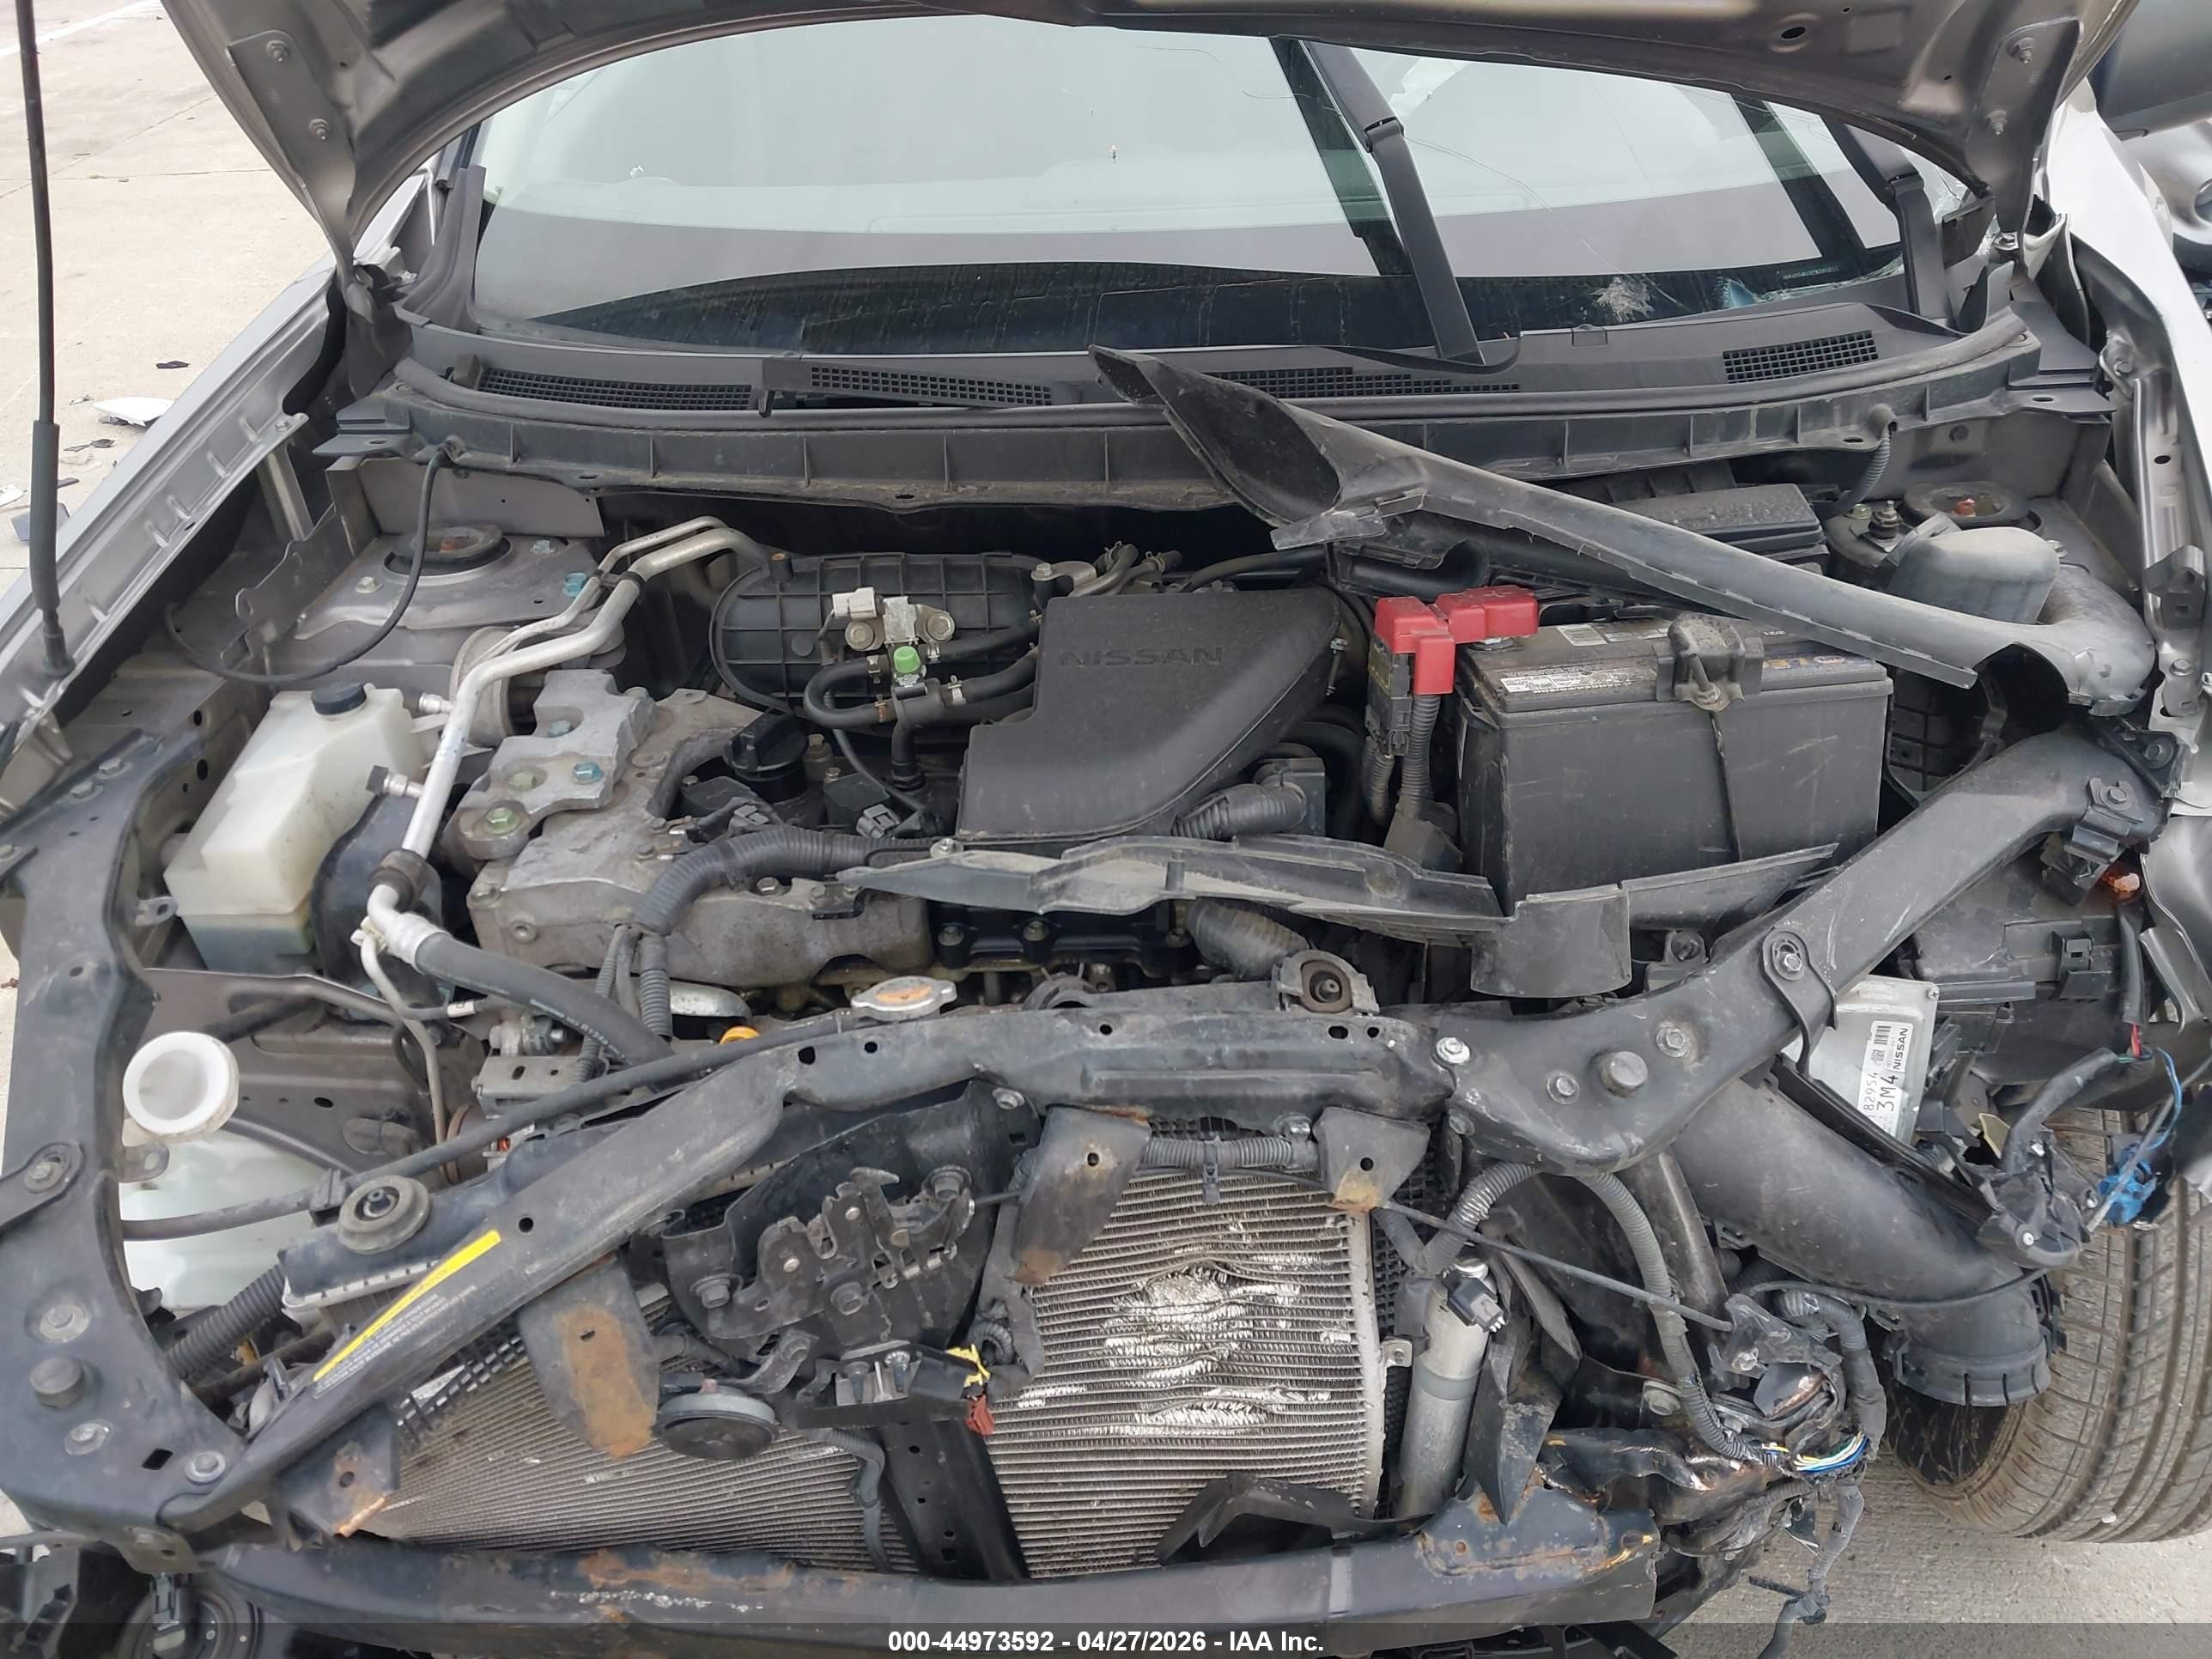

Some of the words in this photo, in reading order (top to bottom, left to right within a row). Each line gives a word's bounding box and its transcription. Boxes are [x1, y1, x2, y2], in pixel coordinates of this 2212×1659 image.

[1060, 647, 1223, 667] NISSAN
[1892, 1027, 1909, 1071] NISSAN
[1876, 1074, 1899, 1112] 3M4
